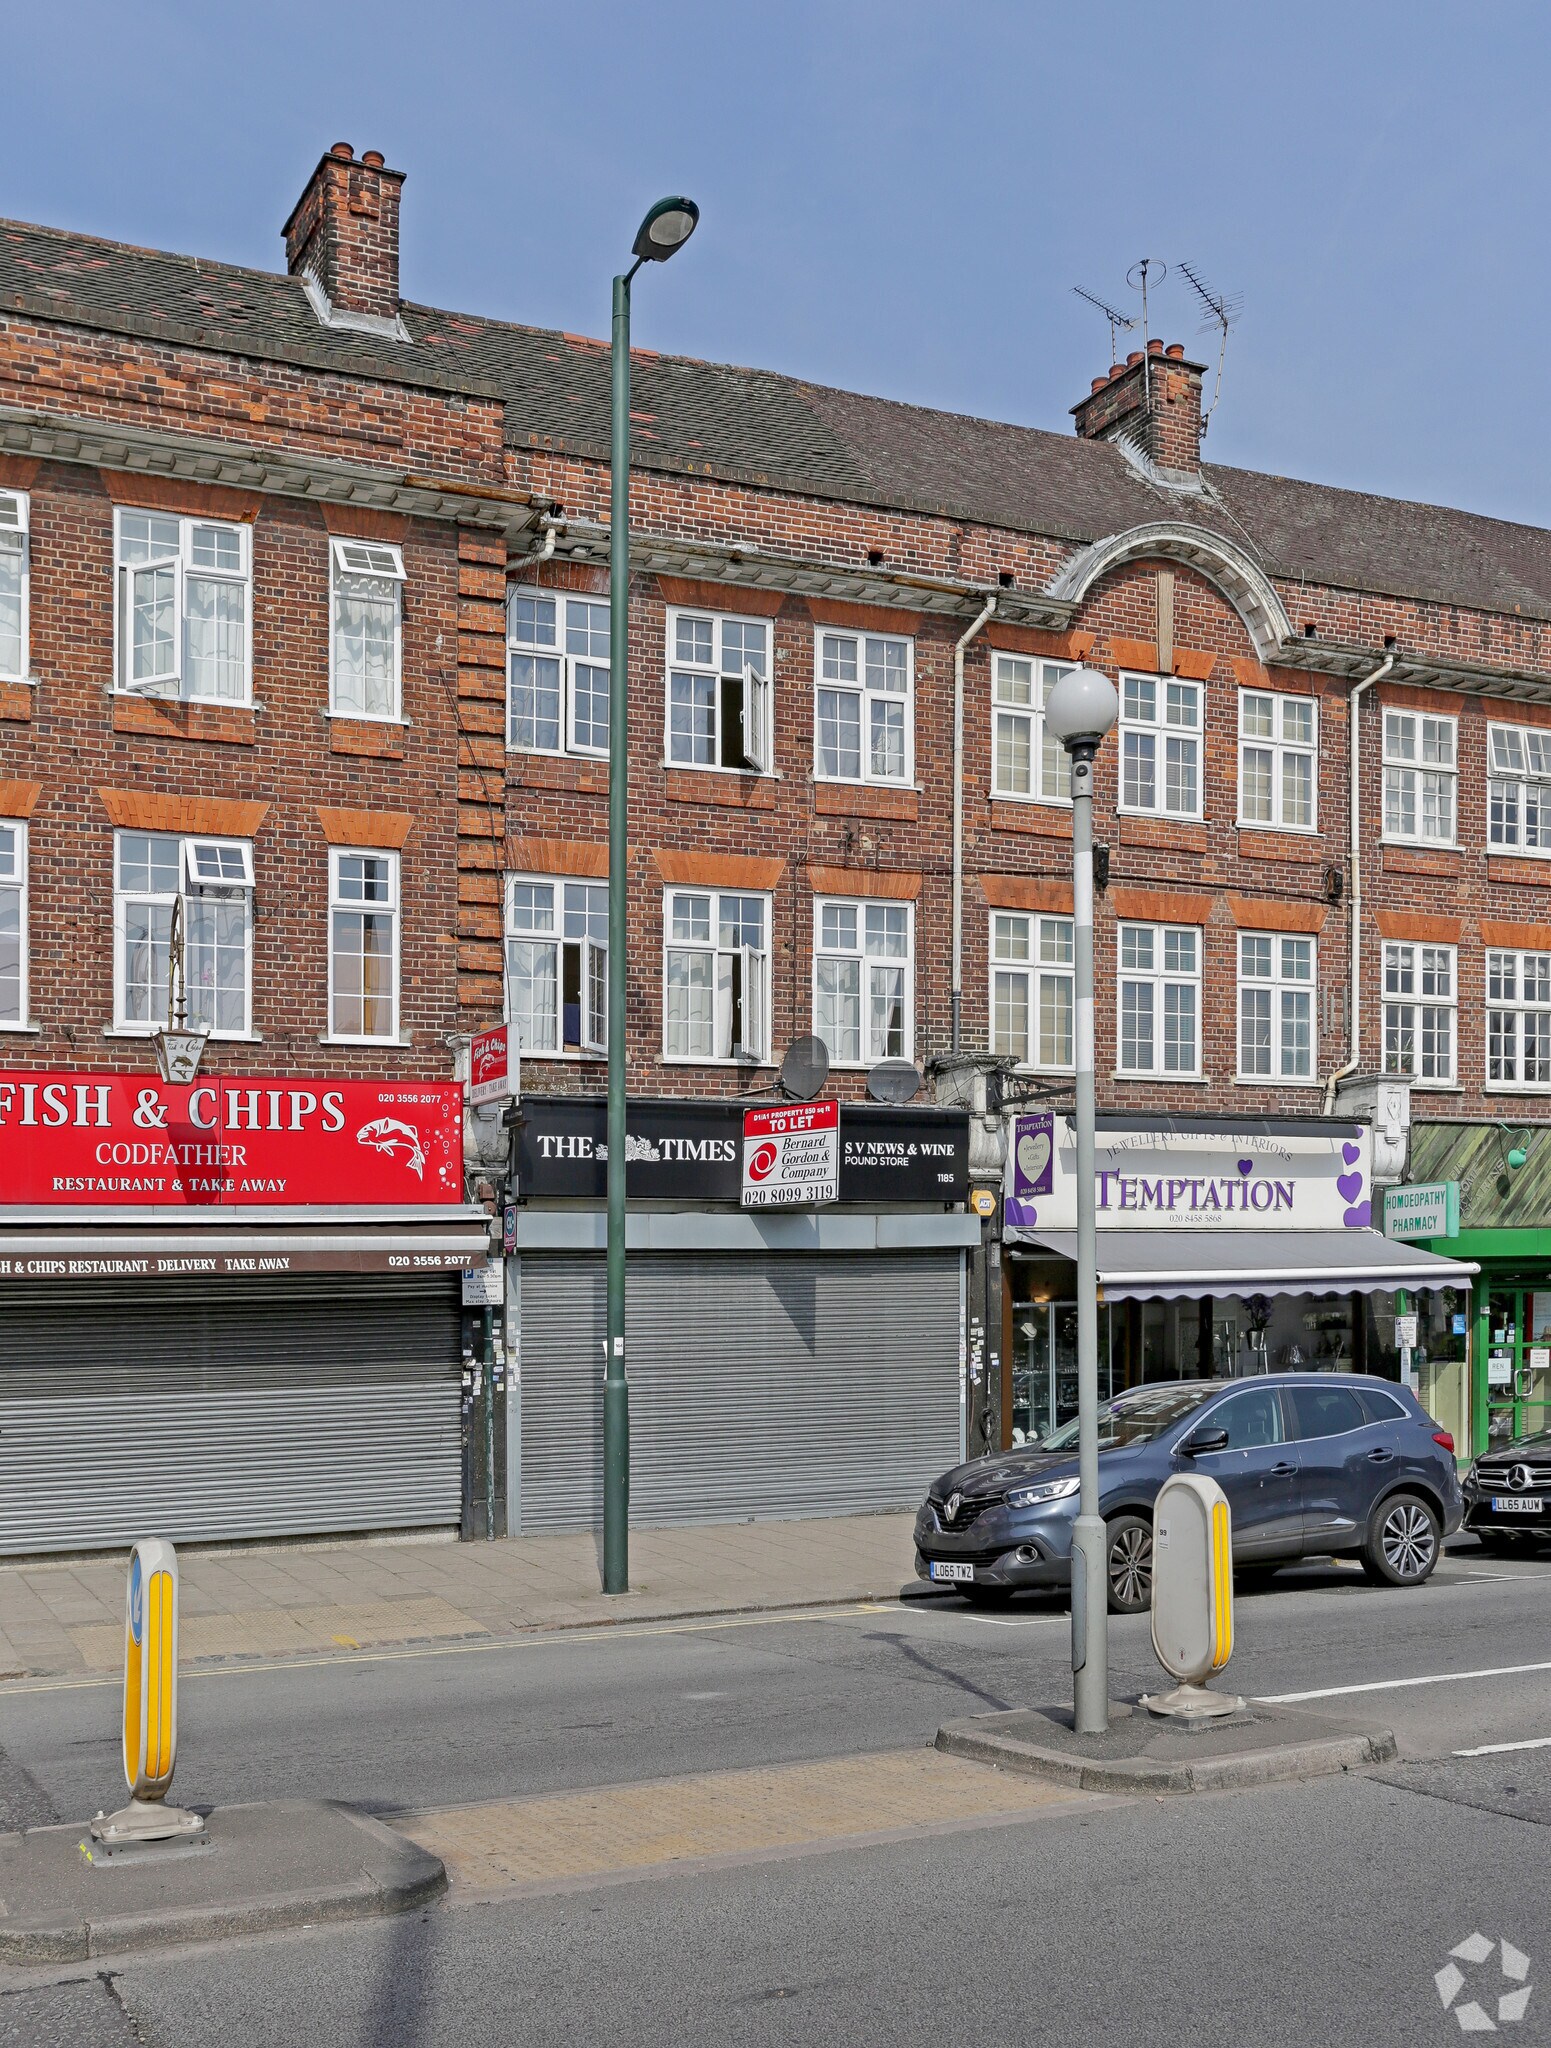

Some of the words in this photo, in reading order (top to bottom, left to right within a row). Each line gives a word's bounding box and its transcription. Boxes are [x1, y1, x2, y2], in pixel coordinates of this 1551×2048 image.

[378, 1093, 395, 1103] 020
[397, 1094, 419, 1103] 3556
[420, 1095, 441, 1104] 2077
[0, 1082, 113, 1127] FISH
[132, 1088, 169, 1129] &
[188, 1088, 346, 1132] CHIPS
[771, 1108, 804, 1120] PROPERTY
[804, 1107, 816, 1115] 850
[769, 1118, 787, 1132] TO
[789, 1115, 814, 1130] LET
[1016, 1119, 1053, 1133] TEMPTATION
[537, 1135, 593, 1159] THE
[782, 1134, 827, 1150] Bernard
[844, 1141, 853, 1154] S
[855, 1142, 865, 1155] V
[866, 1142, 905, 1155] NEWS
[907, 1143, 918, 1156] &
[920, 1143, 955, 1156] WINE
[95, 1142, 248, 1166] CODFATHER
[658, 1138, 736, 1162] TIMES
[781, 1151, 819, 1166] Gordon
[821, 1149, 830, 1161] &
[844, 1156, 878, 1166] POUND
[880, 1157, 909, 1166] STORE
[781, 1166, 830, 1181] Company
[937, 1173, 955, 1183] 1185
[52, 1177, 166, 1191] RESTAURANT
[171, 1179, 184, 1191] &
[188, 1178, 235, 1192] TAKE
[240, 1179, 287, 1192] AWAY
[1095, 1168, 1296, 1212] TEMPTATION
[745, 1189, 767, 1205] 020
[770, 1186, 802, 1203] 8099
[806, 1183, 833, 1200] 3119
[1386, 1190, 1446, 1210] HOMOEOPATHY
[979, 1200, 991, 1208] ADT
[1169, 1214, 1183, 1223] 020
[1185, 1214, 1203, 1223] 8458
[1204, 1214, 1222, 1223] 5868
[1392, 1215, 1438, 1232] PHARMACY
[14, 1261, 24, 1273] &
[27, 1260, 66, 1273] CHIPS
[68, 1259, 149, 1273] RESTAURANT
[157, 1259, 216, 1272] DELIVERY
[224, 1258, 257, 1271] TAKE
[258, 1257, 290, 1270] AWAY
[388, 1256, 410, 1266] 020
[413, 1256, 441, 1266] 3556
[444, 1255, 472, 1265] 2077
[1497, 1499, 1519, 1510] LL65
[1522, 1499, 1540, 1510] AUW
[935, 1564, 954, 1577] LO65
[956, 1565, 972, 1578] TWZ
